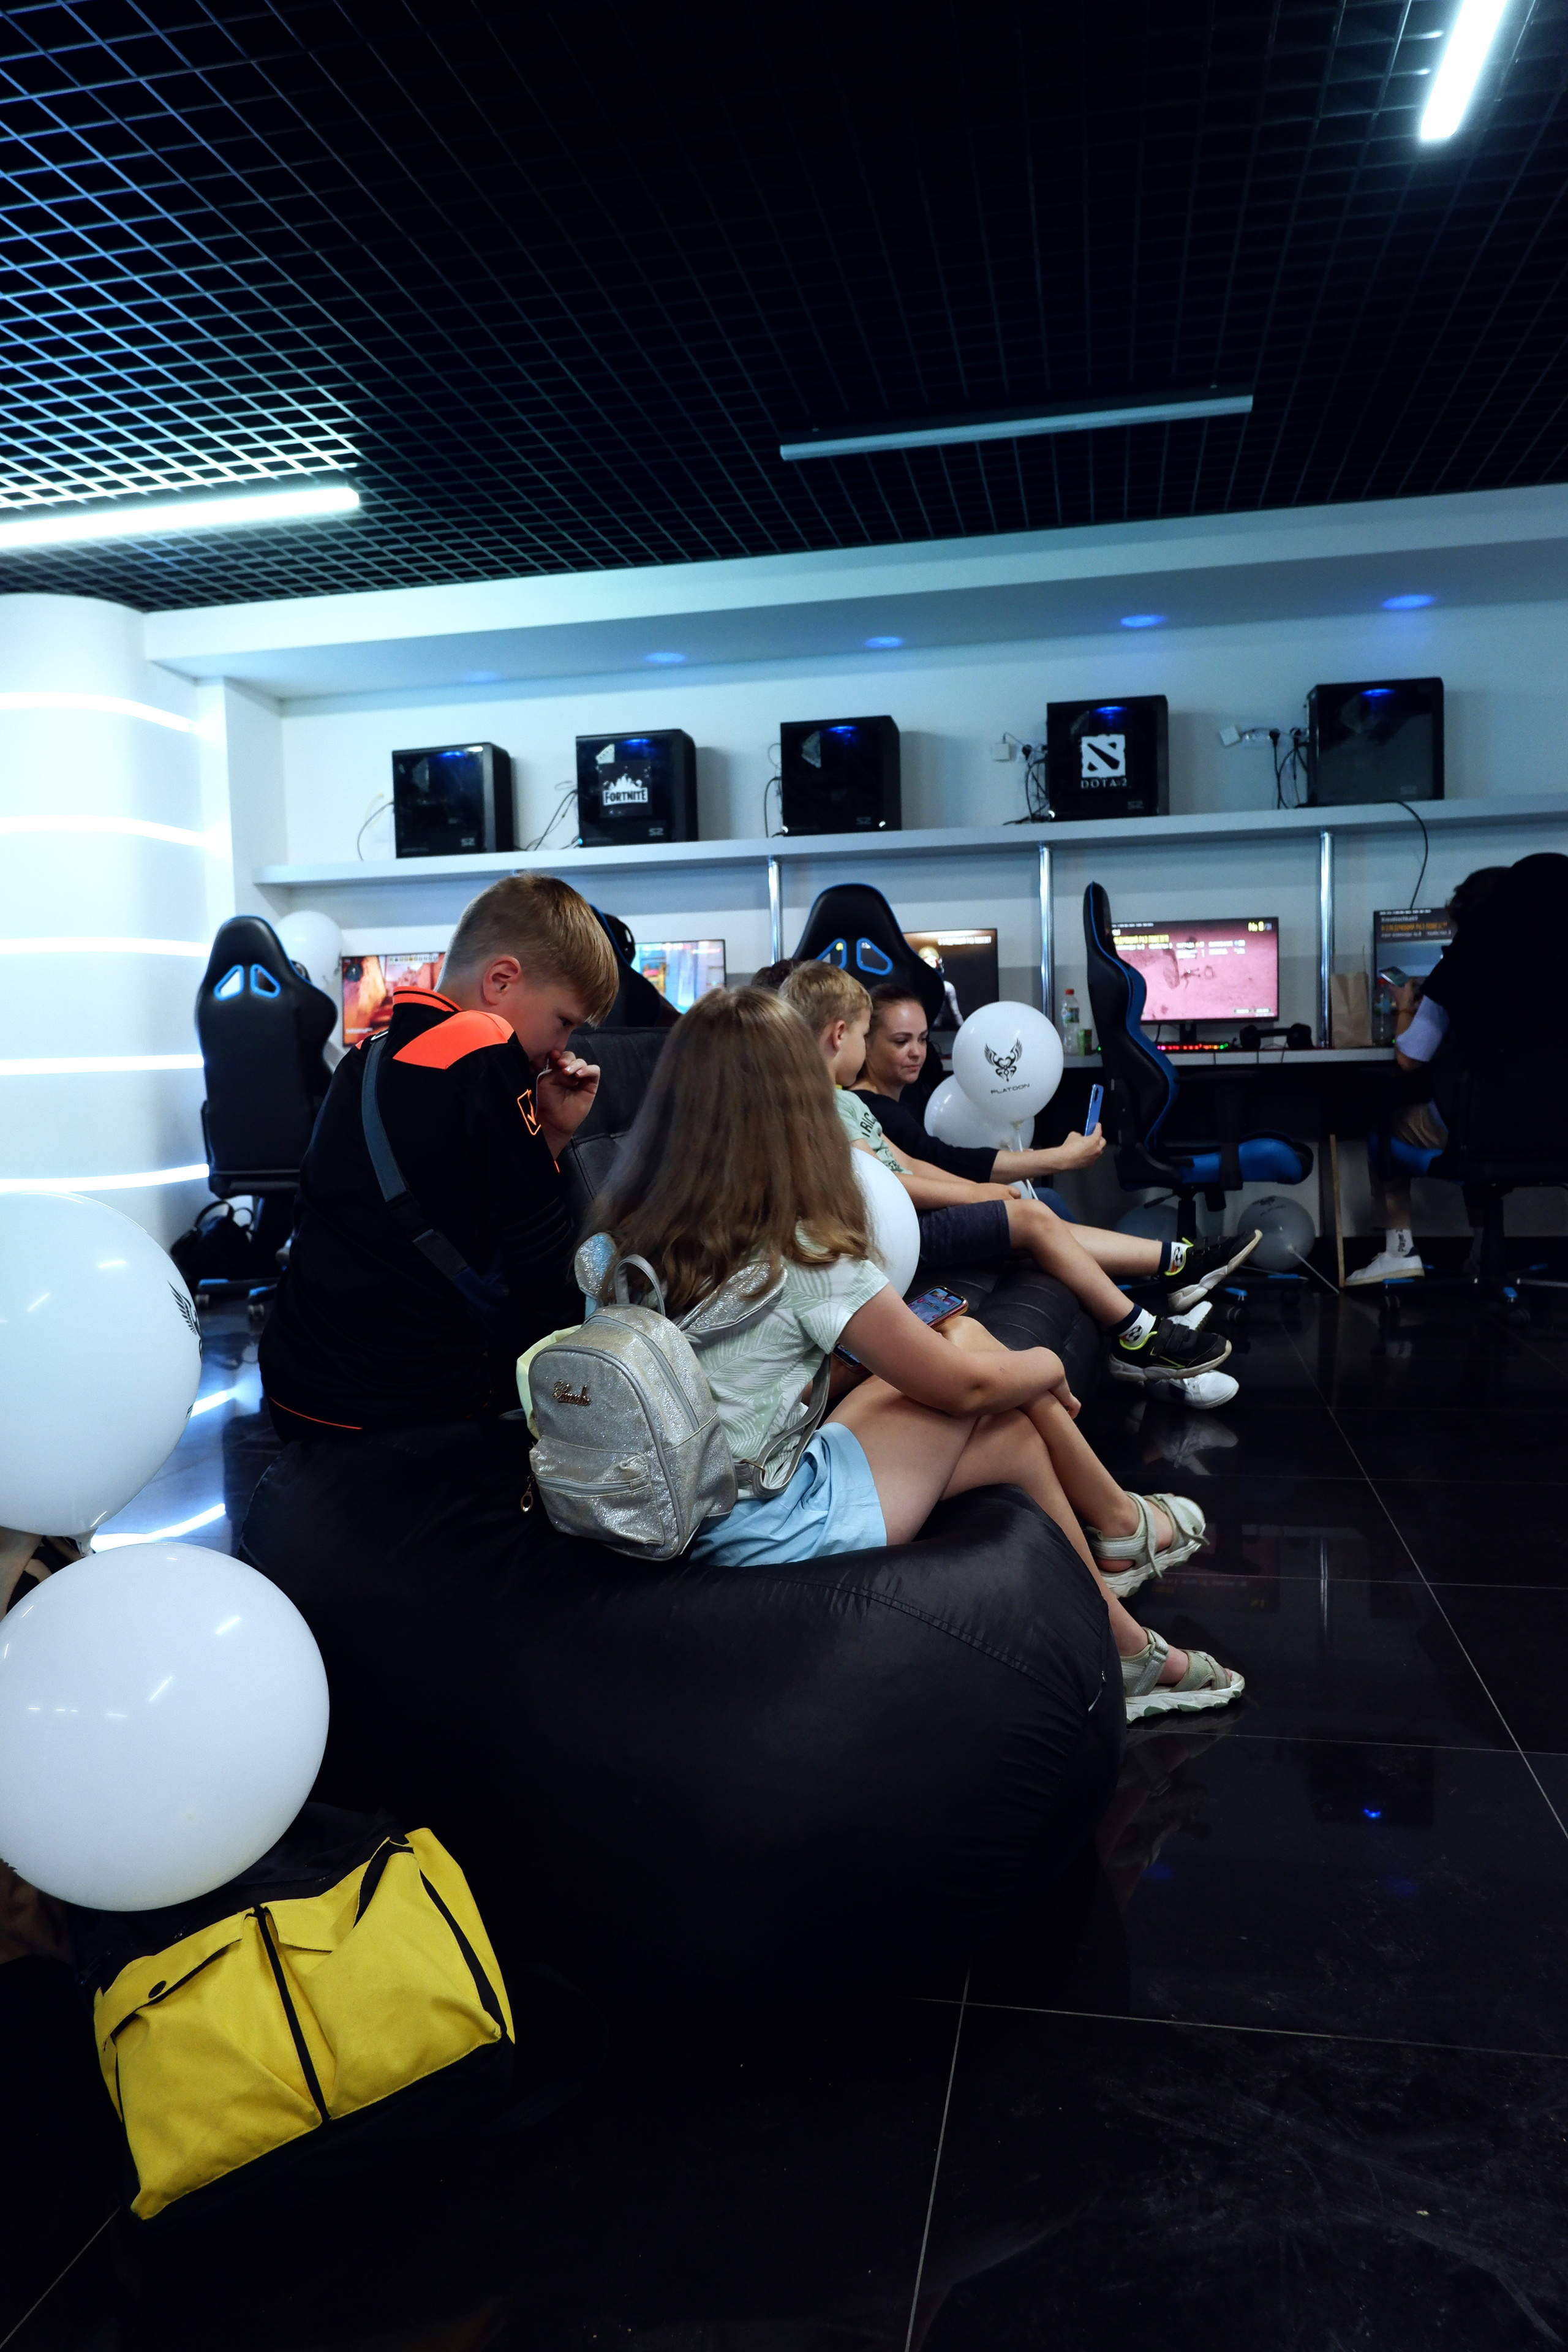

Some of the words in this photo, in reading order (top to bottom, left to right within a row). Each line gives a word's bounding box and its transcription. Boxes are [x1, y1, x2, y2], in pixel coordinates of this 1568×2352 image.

[1080, 779, 1117, 788] DOTA
[605, 790, 645, 803] FORTNITE
[990, 1083, 1030, 1095] PLATOON
